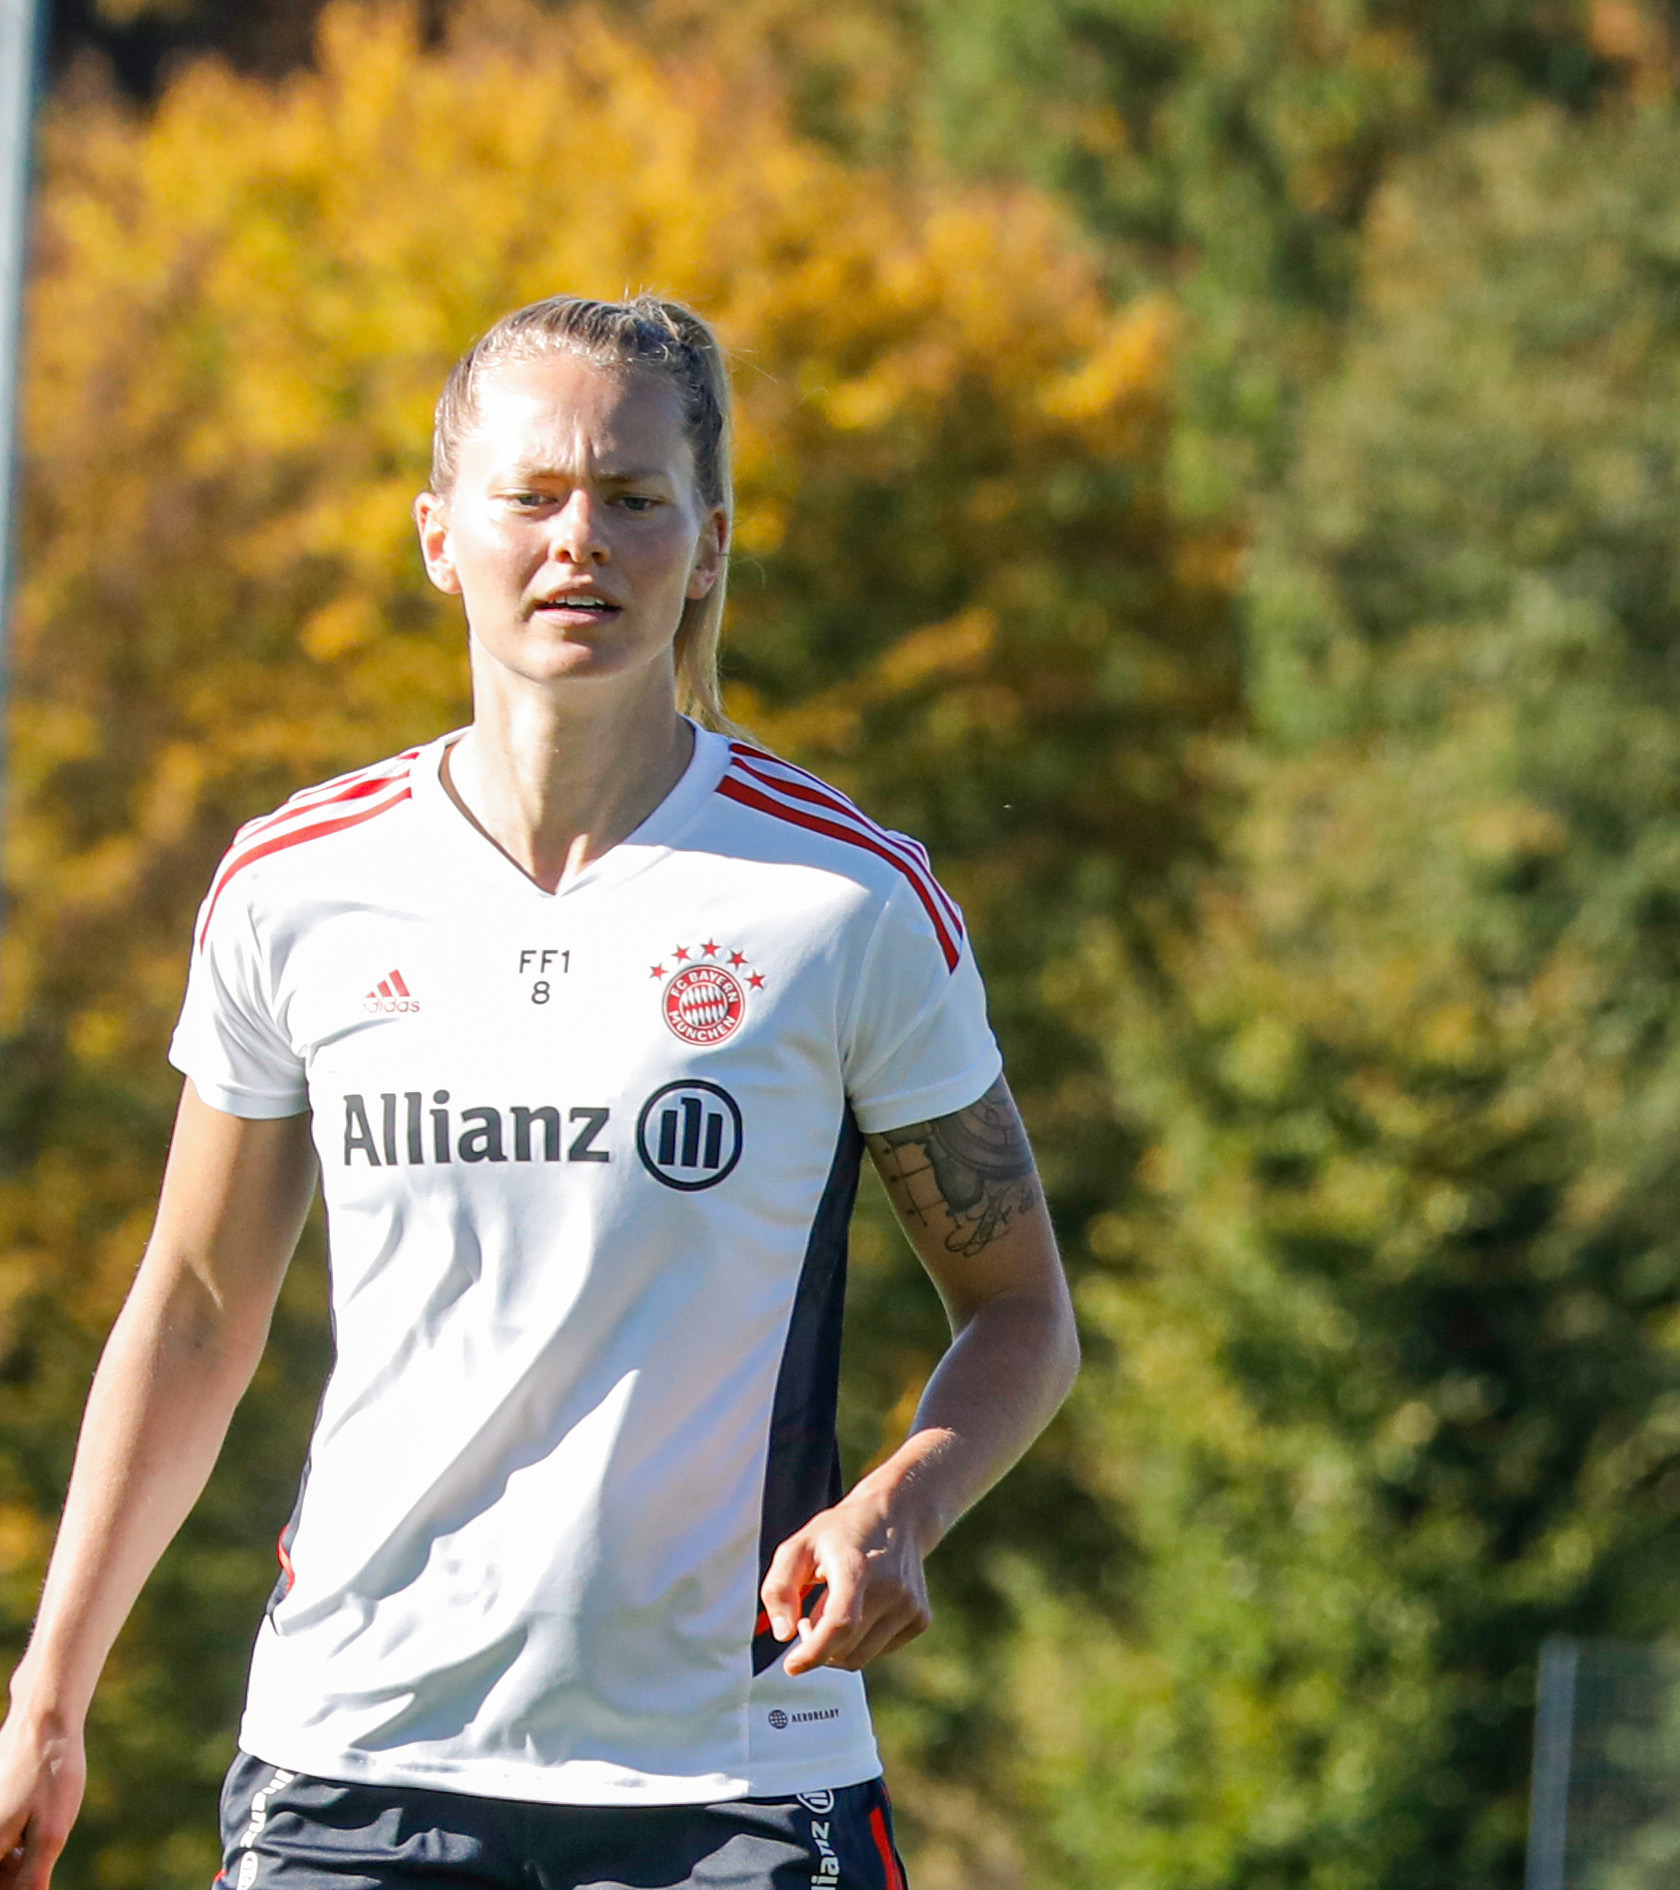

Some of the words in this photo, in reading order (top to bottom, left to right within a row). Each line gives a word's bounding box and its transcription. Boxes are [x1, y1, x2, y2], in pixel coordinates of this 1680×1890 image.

[519, 949, 570, 974] FF1
[531, 980, 550, 1005] 8
[670, 979, 688, 998] FC
[688, 970, 740, 1003] BAYERN
[343, 1089, 610, 1167] Allianz
[791, 1708, 840, 1723] AEROREADY
